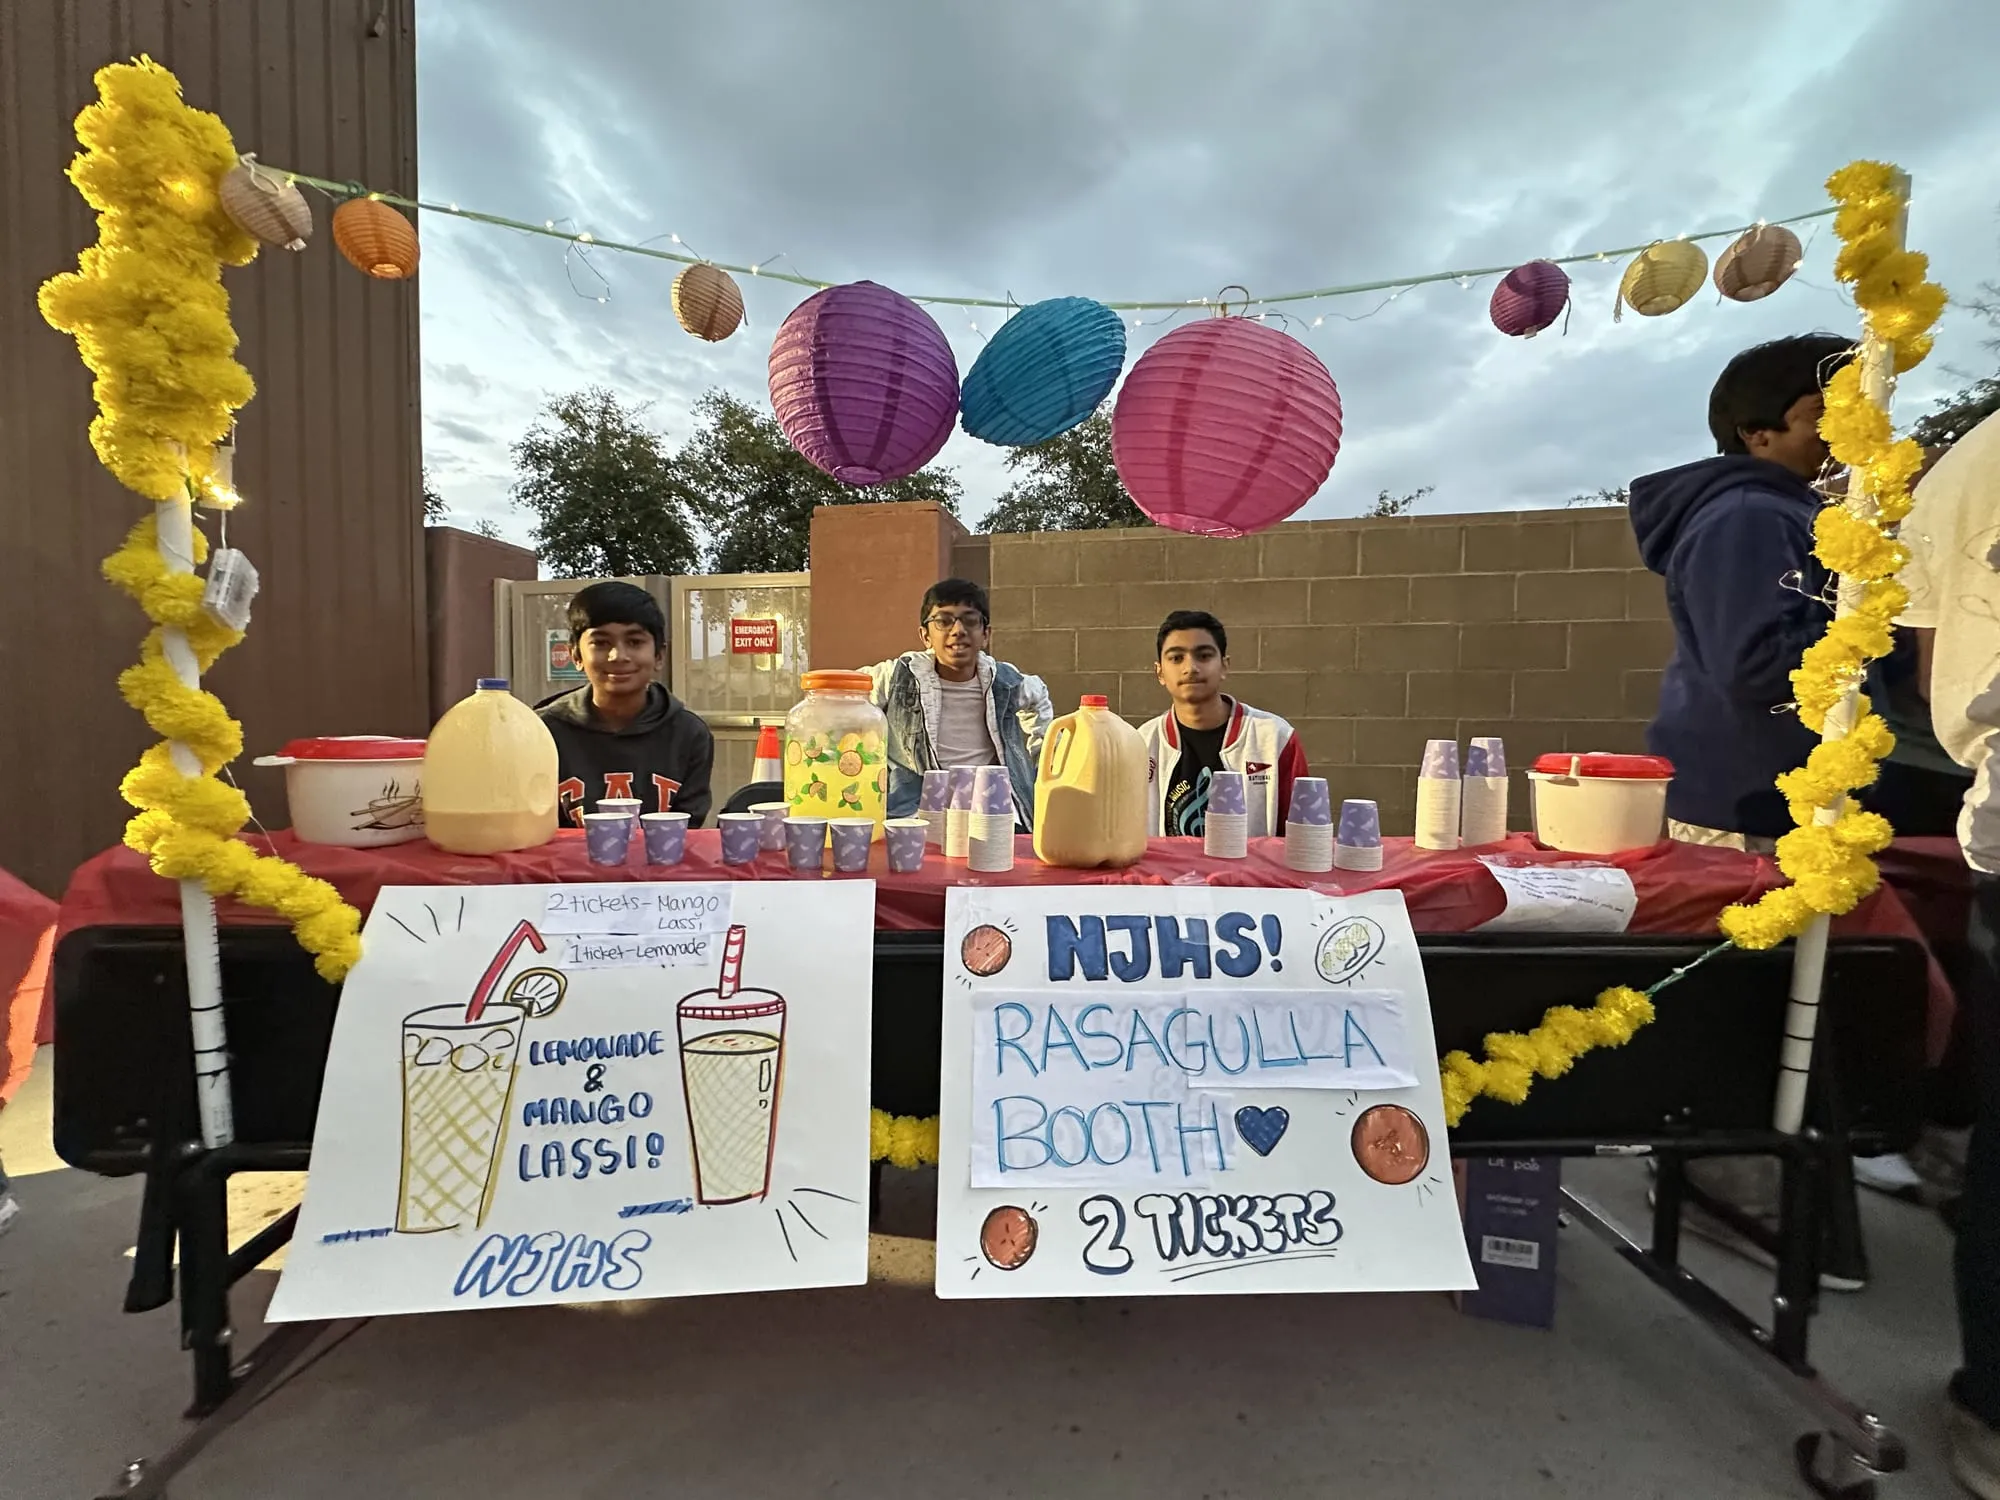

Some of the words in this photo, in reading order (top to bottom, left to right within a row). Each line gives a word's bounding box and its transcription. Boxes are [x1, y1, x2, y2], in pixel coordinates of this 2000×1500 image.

[735, 638, 752, 648] EXIT
[754, 638, 774, 648] ONLY
[658, 895, 719, 916] Mango
[1046, 911, 1284, 982] NJHS!
[529, 1031, 665, 1066] LEMONADE
[995, 1002, 1386, 1077] RASAGULLA
[584, 1063, 607, 1093] &
[523, 1092, 653, 1127] MANGO
[519, 1132, 665, 1182] LASSI!
[992, 1096, 1227, 1177] BOOTH
[1079, 1194, 1134, 1275] 2
[1134, 1190, 1344, 1261] TICKETS
[453, 1229, 652, 1298] NJHS
